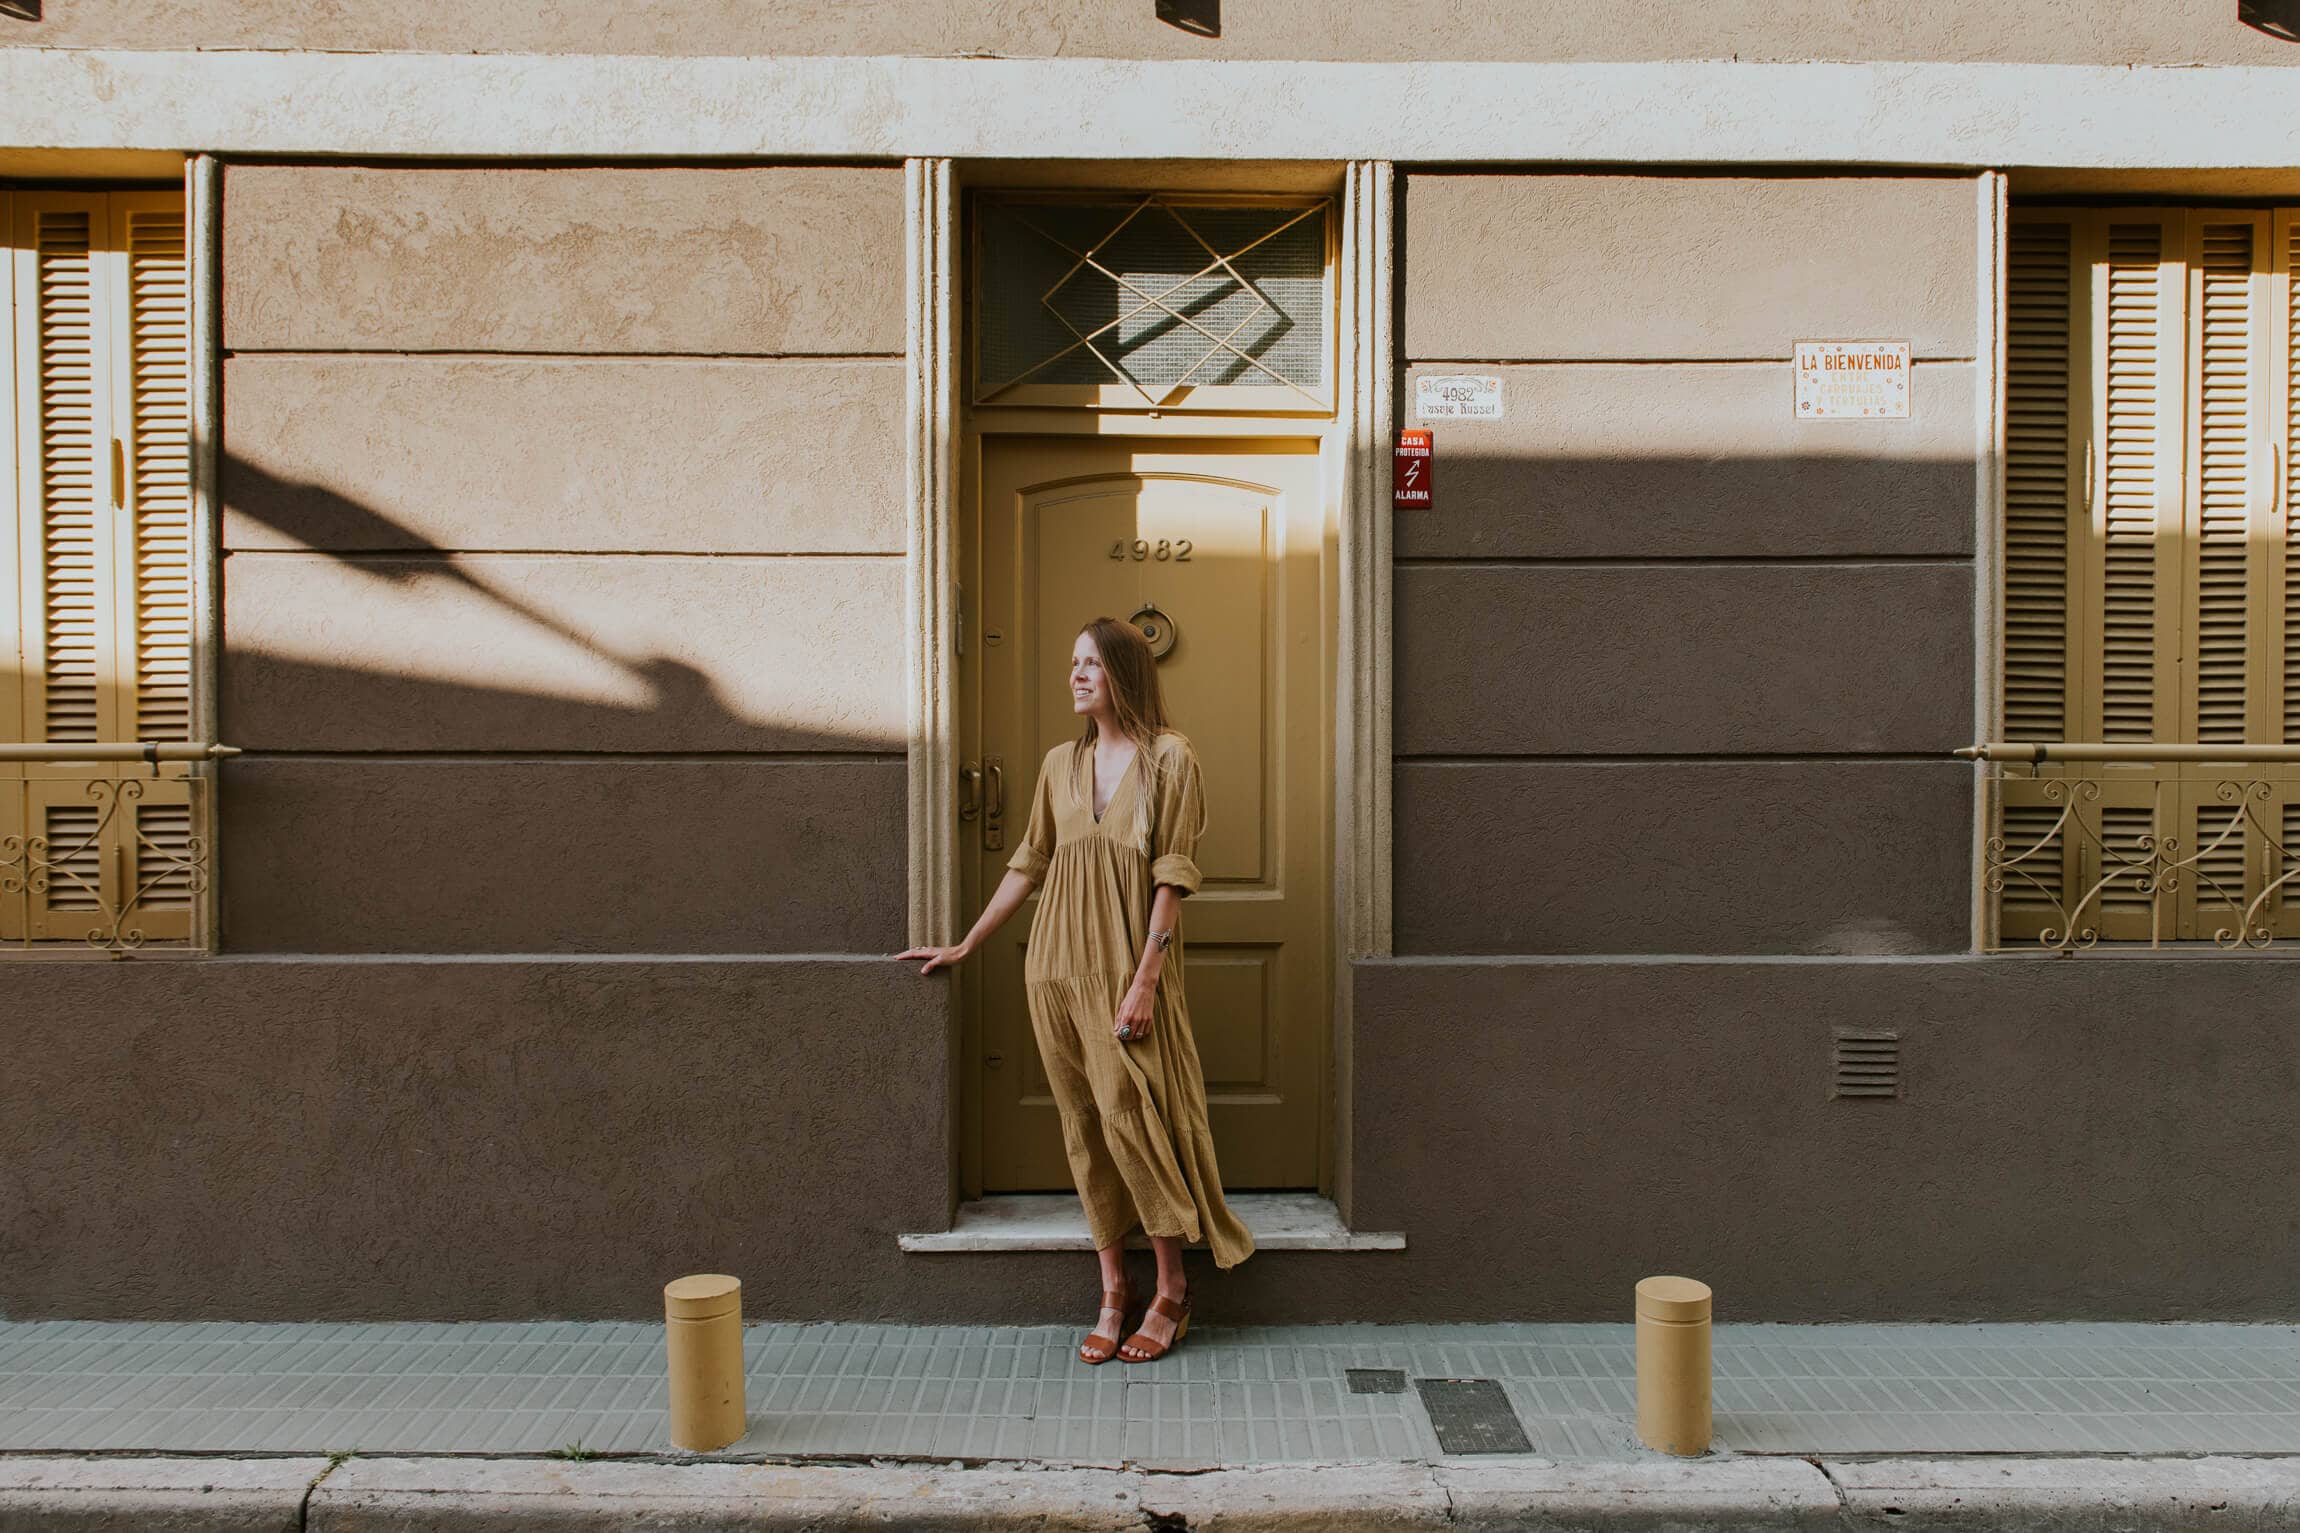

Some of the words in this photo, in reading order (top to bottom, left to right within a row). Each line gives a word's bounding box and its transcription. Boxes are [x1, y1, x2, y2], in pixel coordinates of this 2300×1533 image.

[1801, 353, 1818, 370] LA
[1824, 353, 1903, 370] BIENVENIDA
[1442, 386, 1475, 402] 4982
[1401, 436, 1425, 446] CASA
[1395, 447, 1430, 457] PROTEGIDA
[1394, 490, 1429, 500] ALARMA
[1109, 539, 1193, 562] 4982
